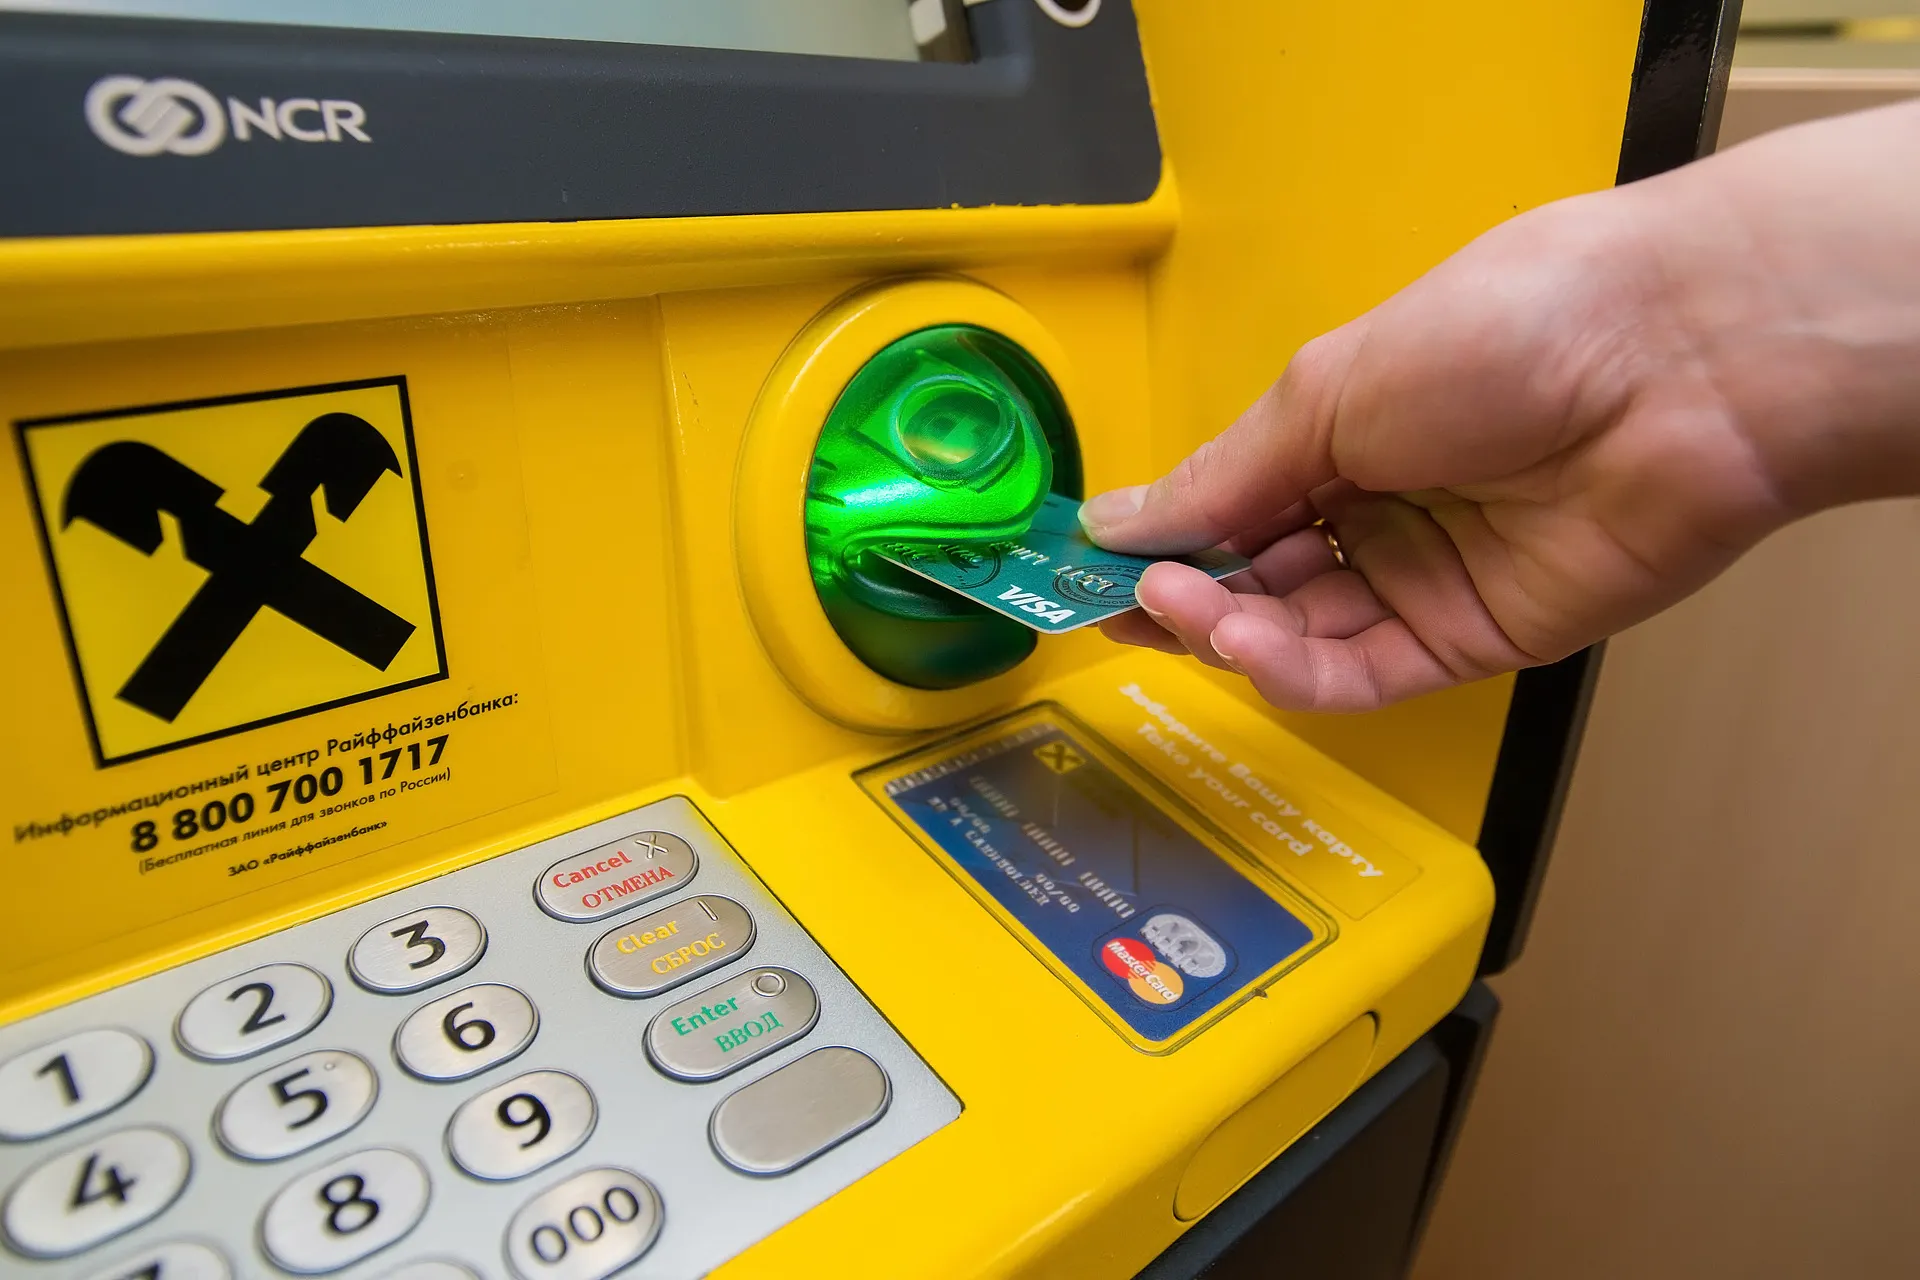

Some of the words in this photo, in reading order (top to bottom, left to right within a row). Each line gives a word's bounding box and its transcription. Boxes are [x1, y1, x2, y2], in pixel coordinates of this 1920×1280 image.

[226, 96, 373, 143] NCR
[997, 584, 1076, 624] VISA
[14, 764, 249, 844] Информационный
[256, 749, 319, 777] центр
[327, 693, 519, 757] Райффайзенбанка:
[131, 820, 158, 853] 8
[172, 792, 255, 841] 800
[267, 766, 344, 814] 700
[358, 734, 449, 785] 1717
[138, 835, 238, 875] (Бесплатная
[242, 820, 287, 842] линия
[290, 812, 315, 829] для
[319, 794, 376, 818] звонков
[379, 786, 396, 800] по
[400, 767, 451, 793] России)
[1188, 766, 1250, 810] your
[1249, 811, 1313, 856] card
[228, 859, 260, 877] ЗАО
[263, 821, 388, 865] «Райффайзенбанк»
[552, 851, 633, 888] Cancel
[1301, 818, 1384, 877] карту
[582, 865, 675, 909] ОТМЕНА
[390, 919, 446, 970] 3
[616, 920, 680, 954] Clear
[651, 932, 726, 975] СБРОС
[1106, 940, 1180, 1001] MasterCard
[225, 982, 286, 1036] 2
[442, 1001, 496, 1051] 6
[670, 996, 739, 1037] Enter
[714, 1011, 784, 1053] ВВОД
[35, 1052, 82, 1105] 1
[269, 1067, 329, 1131] 5
[497, 1093, 551, 1149] 9
[67, 1153, 138, 1213] 4
[317, 1173, 380, 1235] 8
[530, 1186, 640, 1264] 000
